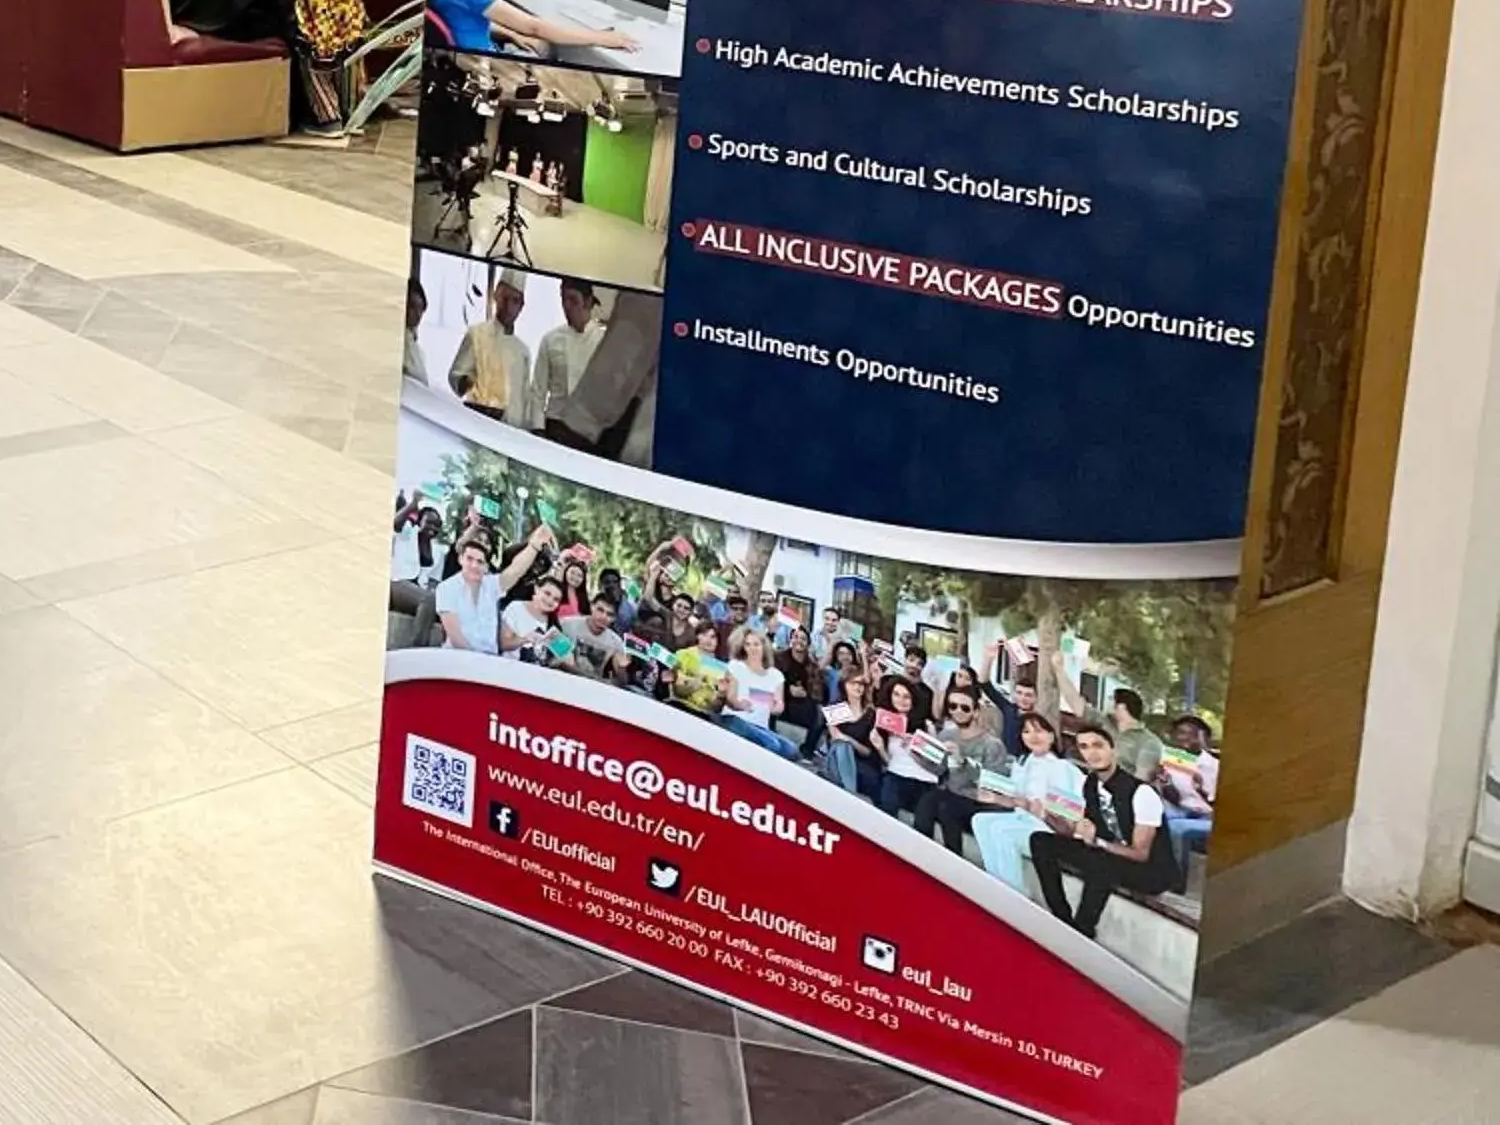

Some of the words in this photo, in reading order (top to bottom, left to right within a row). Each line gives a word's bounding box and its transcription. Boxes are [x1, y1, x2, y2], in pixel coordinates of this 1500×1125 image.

[715, 38, 769, 68] High
[773, 46, 883, 82] Academic
[887, 62, 1060, 106] Achievements
[1067, 85, 1240, 131] Scholarships
[707, 133, 779, 163] Sports
[785, 150, 827, 171] and
[834, 153, 926, 189] Cultural
[932, 169, 1092, 216] Scholarships
[699, 223, 750, 254] ALL
[756, 232, 901, 283] INCLUSIVE
[908, 261, 1061, 313] PACKAGES
[1068, 294, 1256, 348] Opportunities
[693, 319, 830, 367] Installments
[836, 349, 1000, 404] Opportunities
[487, 764, 705, 852] www.eul.edu.tr/en/
[489, 712, 840, 855] intoffice@eul.edu.tr
[521, 826, 616, 873] /EULofficial
[423, 821, 443, 838] The
[446, 830, 518, 866] International
[559, 872, 581, 890] The
[584, 881, 641, 912] European
[644, 902, 707, 938] University
[709, 929, 723, 942] of
[896, 996, 935, 1020] TRNC
[937, 1010, 959, 1030] Via
[963, 1020, 1013, 1048] Mersin
[1041, 1047, 1104, 1080] TURKEY
[576, 900, 604, 919] +90
[607, 908, 633, 931] 392
[635, 921, 664, 942] 660
[667, 931, 687, 950] 20
[688, 940, 709, 958] 00
[755, 968, 785, 986] +90
[789, 976, 818, 1000] 392
[821, 990, 852, 1012] 660
[854, 1002, 875, 1020] 23
[878, 1012, 900, 1031] 43
[902, 964, 973, 1002] eul_lau
